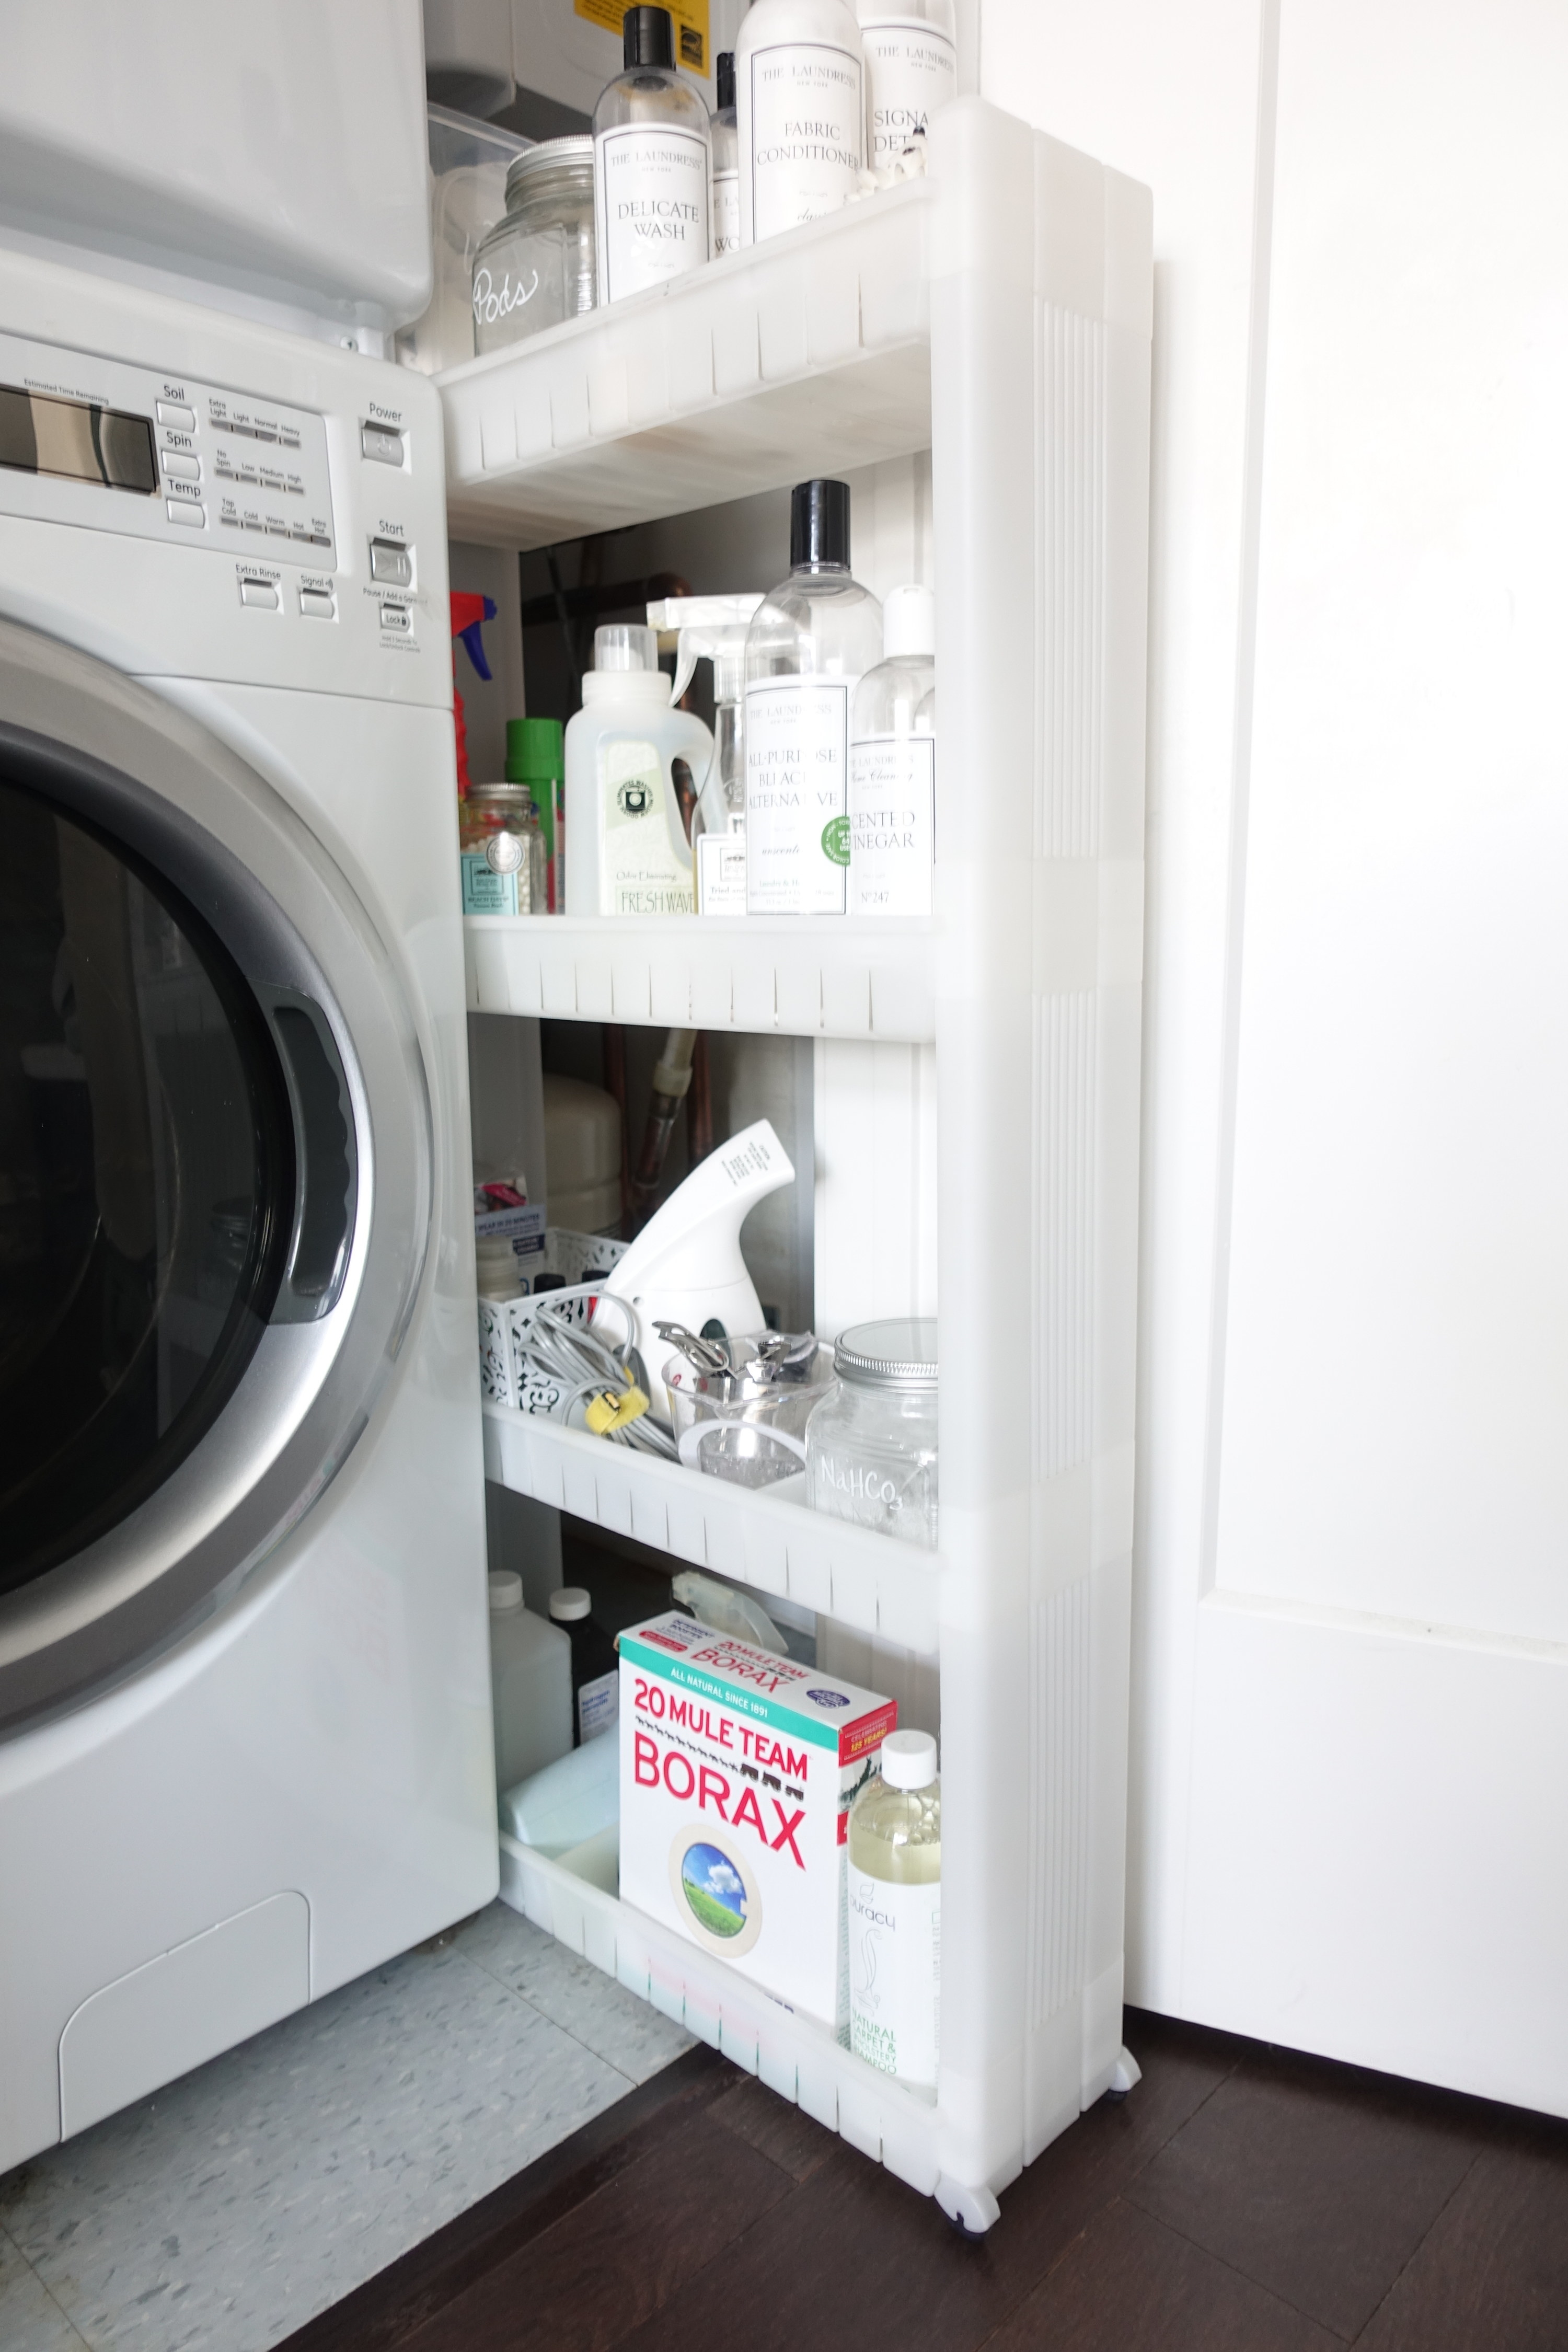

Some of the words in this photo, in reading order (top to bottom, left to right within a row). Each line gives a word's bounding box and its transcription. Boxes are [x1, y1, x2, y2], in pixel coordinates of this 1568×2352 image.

[876, 46, 899, 57] THE
[762, 67, 783, 82] THE
[792, 65, 856, 90] LAUNDRESS
[784, 121, 840, 140] FABRIC
[611, 153, 630, 167] THE
[636, 151, 701, 171] LAUNDRESS
[757, 145, 859, 174] CONDITIONER
[618, 200, 699, 223] DELICATE
[634, 223, 685, 241] WASH
[473, 268, 537, 325] Pods
[24, 379, 57, 393] Estimated
[59, 386, 75, 396] Time
[75, 391, 109, 406] Remaining
[164, 384, 185, 400] Soil
[209, 399, 226, 409] Extra
[370, 402, 402, 422] Power
[210, 408, 227, 418] Light
[233, 412, 249, 423] Light
[255, 418, 278, 430] Normal
[281, 425, 300, 437] Heavy
[167, 431, 192, 447] Spin
[216, 458, 230, 467] Spin
[242, 463, 255, 472] Low
[259, 466, 284, 479] Medium
[287, 473, 302, 484] High
[168, 479, 201, 497] Temp
[222, 498, 234, 508] Tap
[222, 506, 237, 516] Cold
[244, 511, 258, 521] Cold
[266, 515, 285, 526] Warm
[293, 521, 304, 531] Hot
[379, 520, 405, 537] Start
[236, 563, 257, 576] Extra
[259, 567, 281, 580] Rinse
[301, 575, 324, 588] Signal
[386, 614, 401, 625] Lock
[750, 708, 763, 720] THE
[767, 704, 832, 718] LAUNDSS
[748, 748, 837, 768] ALL-PURSE
[859, 755, 914, 767] LAUNDRS
[870, 769, 914, 782] Cleang
[748, 792, 838, 810] ALTERNAVE
[852, 832, 915, 850] INEGAR
[762, 844, 800, 856] unscent
[617, 870, 637, 881] Odor
[639, 870, 676, 883] Eliminating
[710, 885, 729, 894] Tried
[621, 891, 663, 914] FRESH
[666, 891, 694, 914] WAVE
[718, 1641, 742, 1652] 20
[742, 1648, 775, 1665] MULE
[774, 1662, 810, 1680] TEAM
[690, 1648, 791, 1694] BORAX
[671, 1667, 685, 1682] ALL
[687, 1674, 723, 1699] NATURAL
[725, 1689, 749, 1710] SINCE
[751, 1702, 768, 1718] 1891
[635, 1678, 665, 1719] 20
[670, 1694, 734, 1749] MULE
[739, 1725, 808, 1782] TEAM
[851, 1740, 863, 1753] 125
[635, 1730, 806, 1872] BORAX
[852, 2007, 896, 2043] NATURAL
[887, 2042, 896, 2055] &
[854, 2046, 897, 2075] HAMPOO
